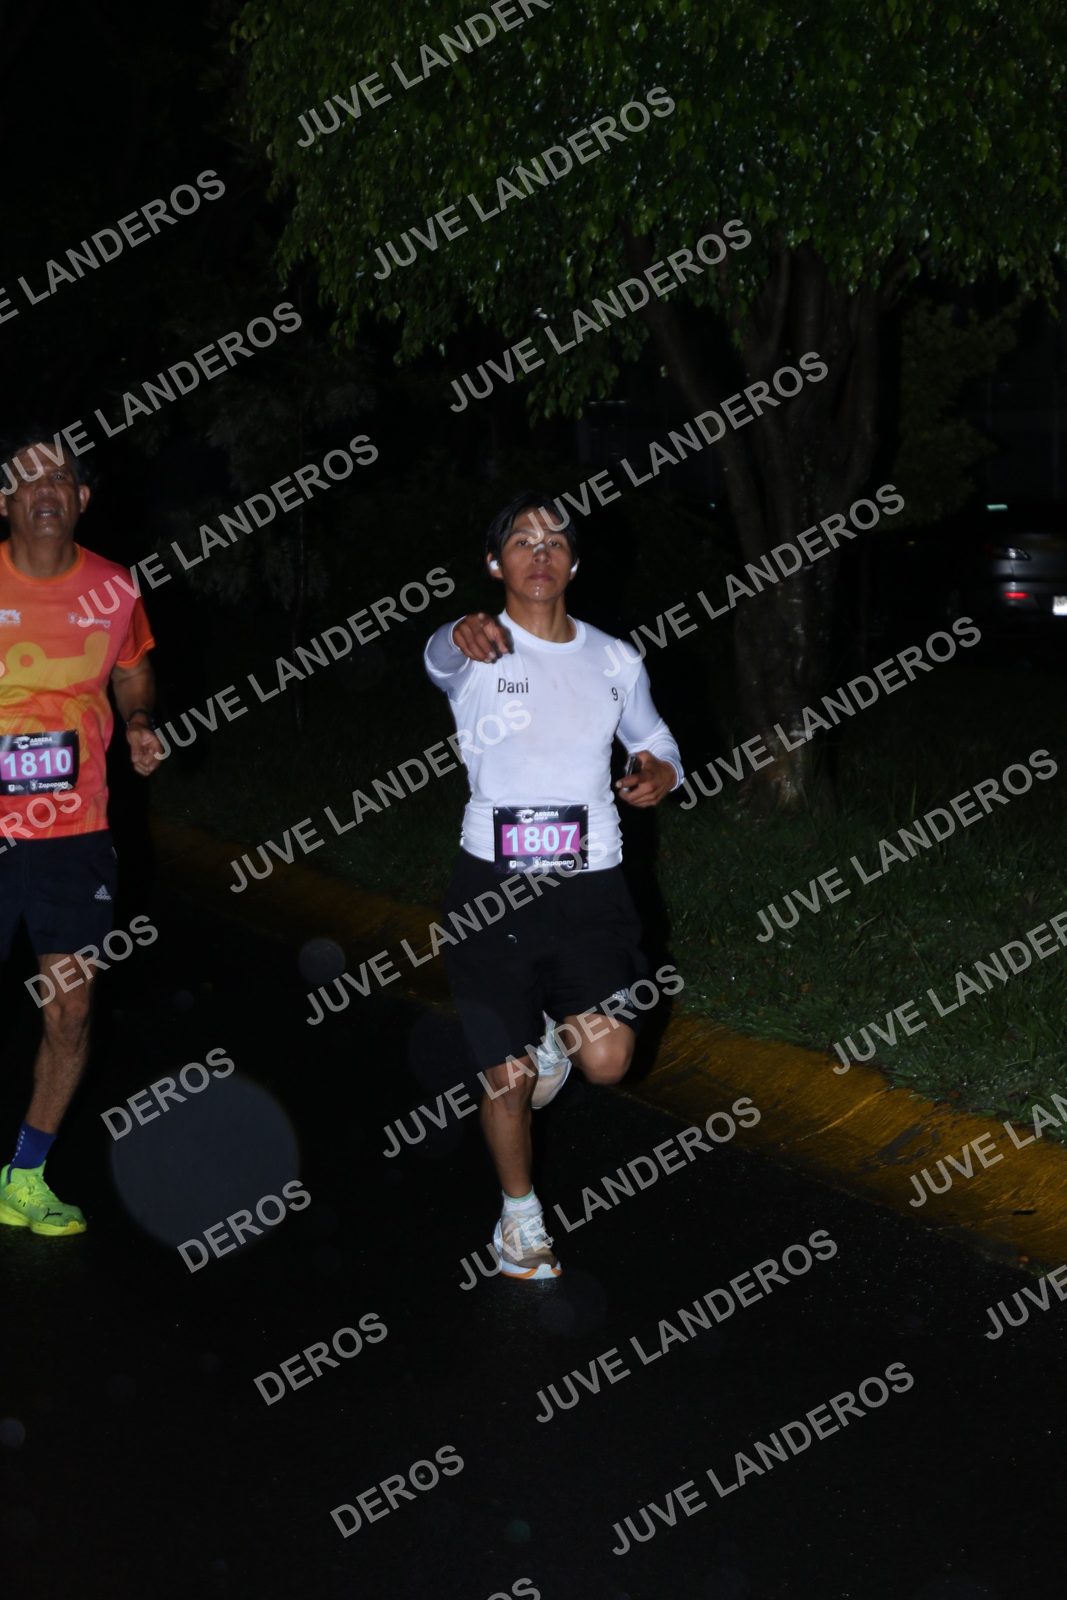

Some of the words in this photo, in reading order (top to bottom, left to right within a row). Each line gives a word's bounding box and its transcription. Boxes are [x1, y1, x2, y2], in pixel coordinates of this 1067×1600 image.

[497, 677, 529, 693] Dani
[611, 686, 619, 701] 9
[4, 749, 71, 777] 1810
[506, 825, 578, 852] 1807
